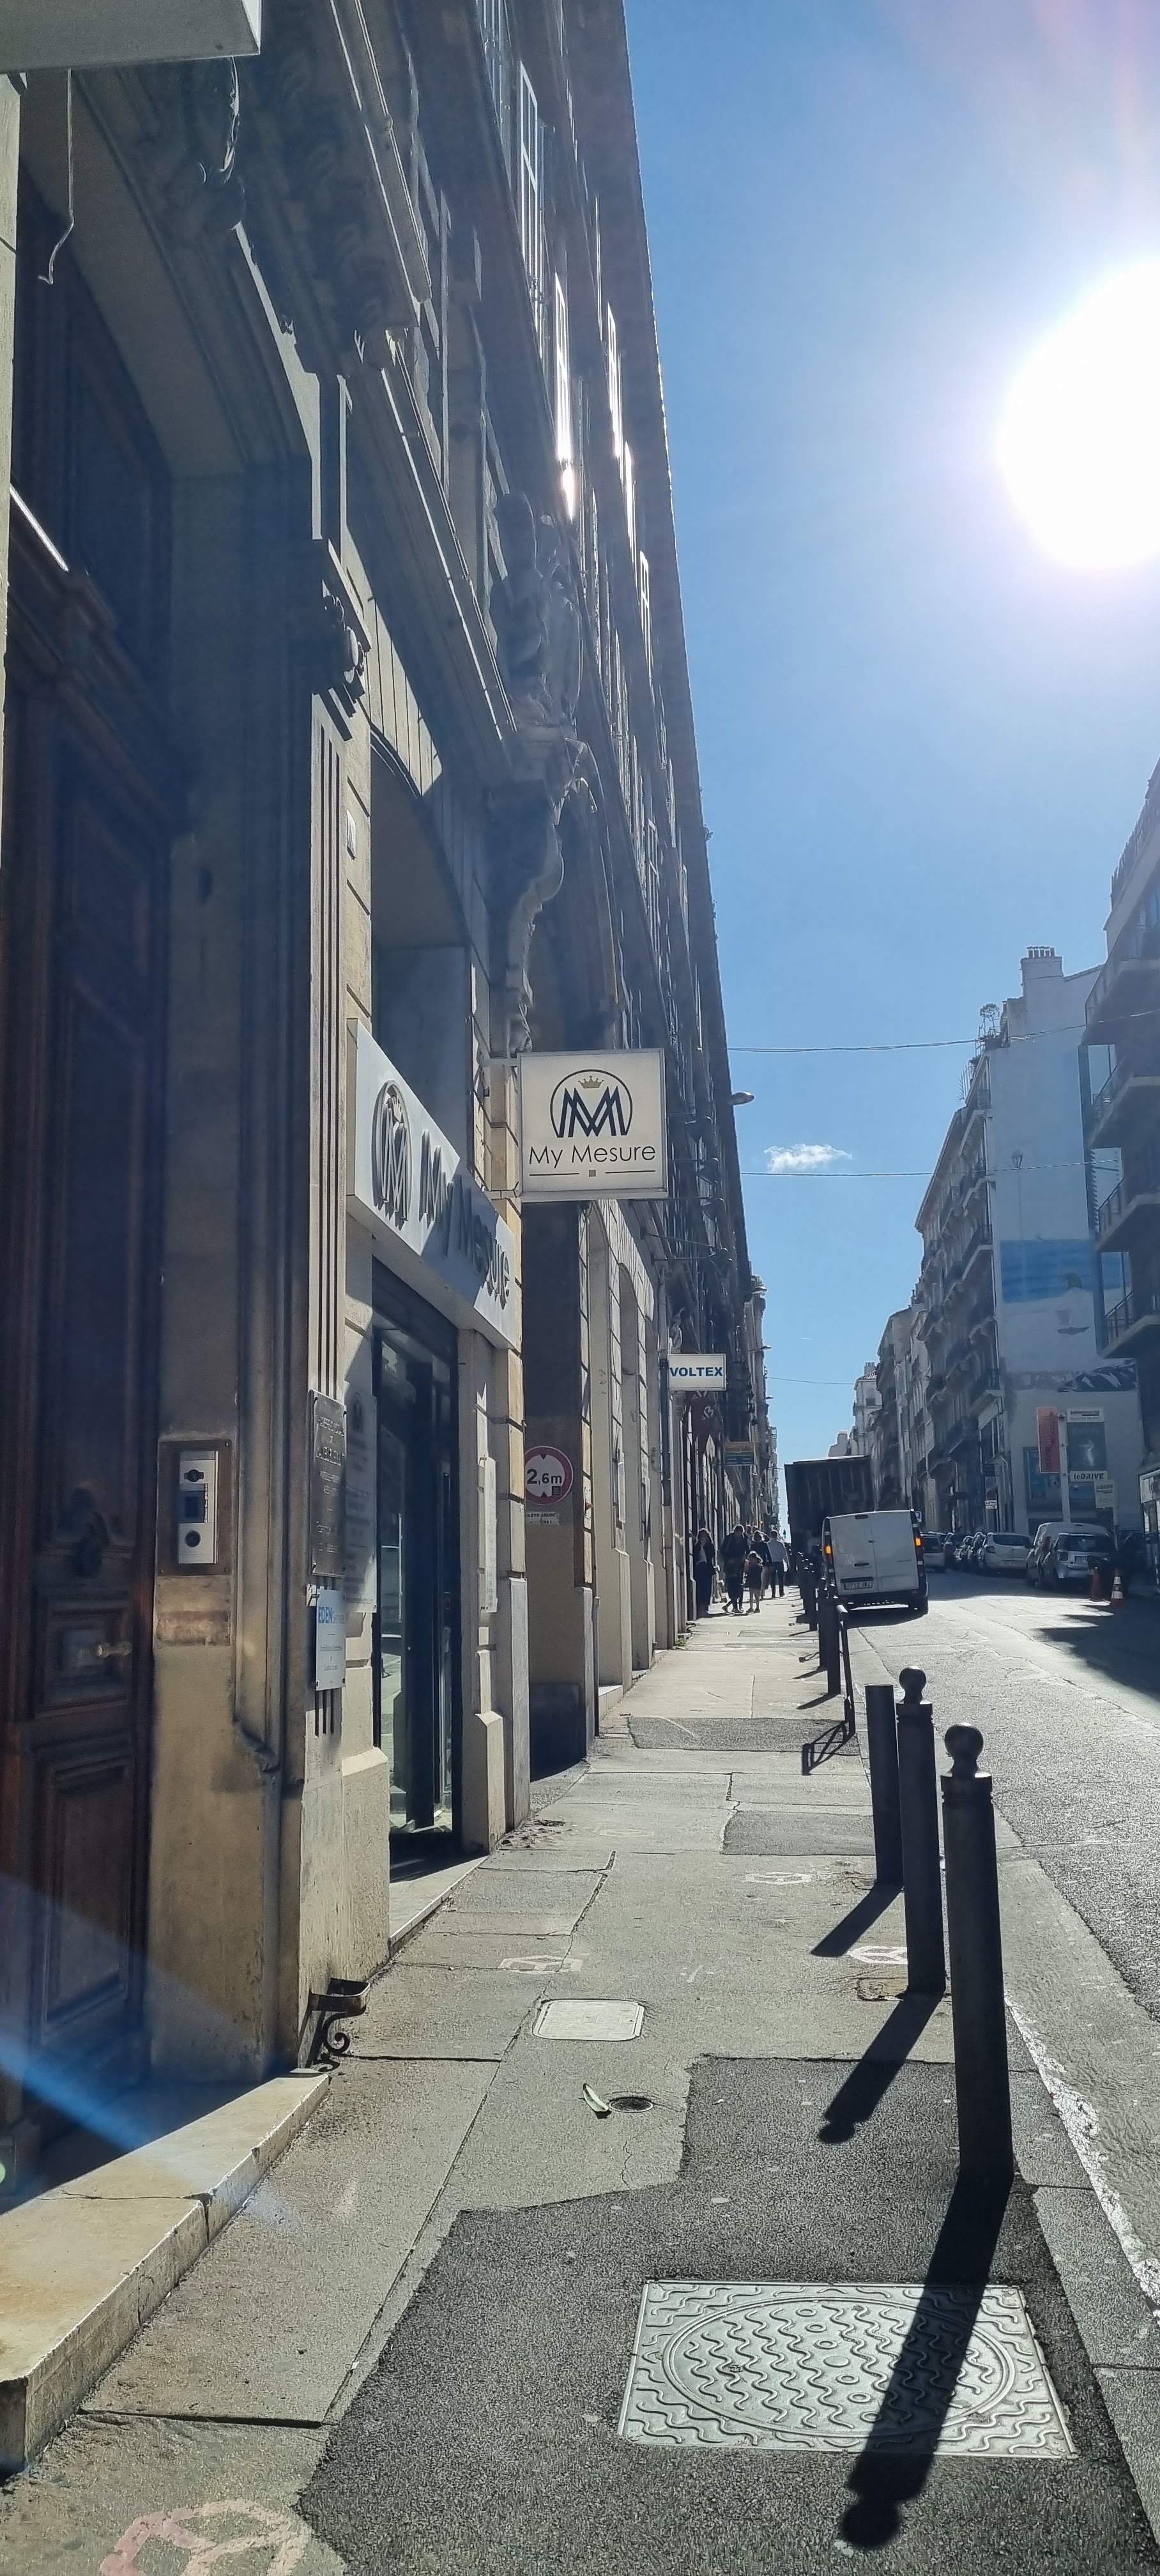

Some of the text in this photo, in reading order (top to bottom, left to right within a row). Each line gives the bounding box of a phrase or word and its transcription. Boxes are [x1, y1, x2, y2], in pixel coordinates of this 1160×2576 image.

[529, 1144, 655, 1169] My Mesure
[669, 1367, 723, 1377] VOLTEX
